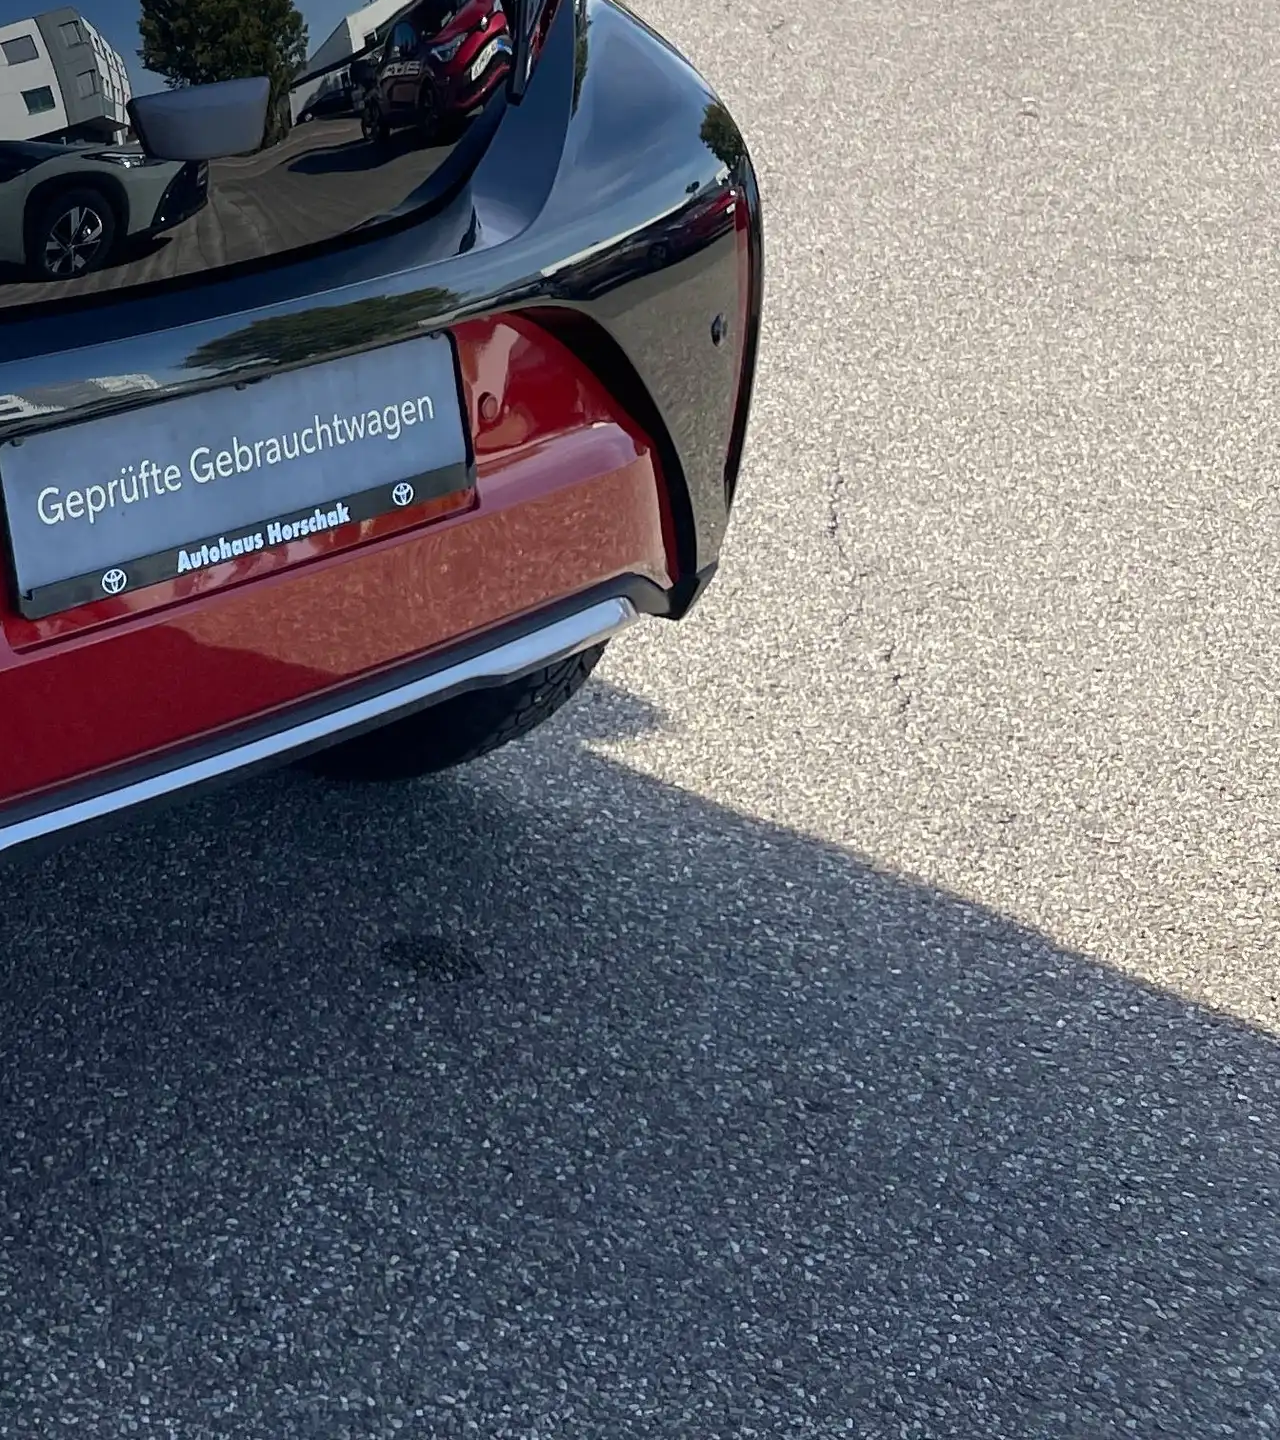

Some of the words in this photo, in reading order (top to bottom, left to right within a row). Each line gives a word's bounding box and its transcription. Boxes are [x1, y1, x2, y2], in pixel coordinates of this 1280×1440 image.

[37, 460, 182, 524] Geprüfte
[189, 395, 434, 484] Gebrauchtwagen
[177, 532, 264, 573] Autohaus
[267, 502, 351, 545] Horschak
